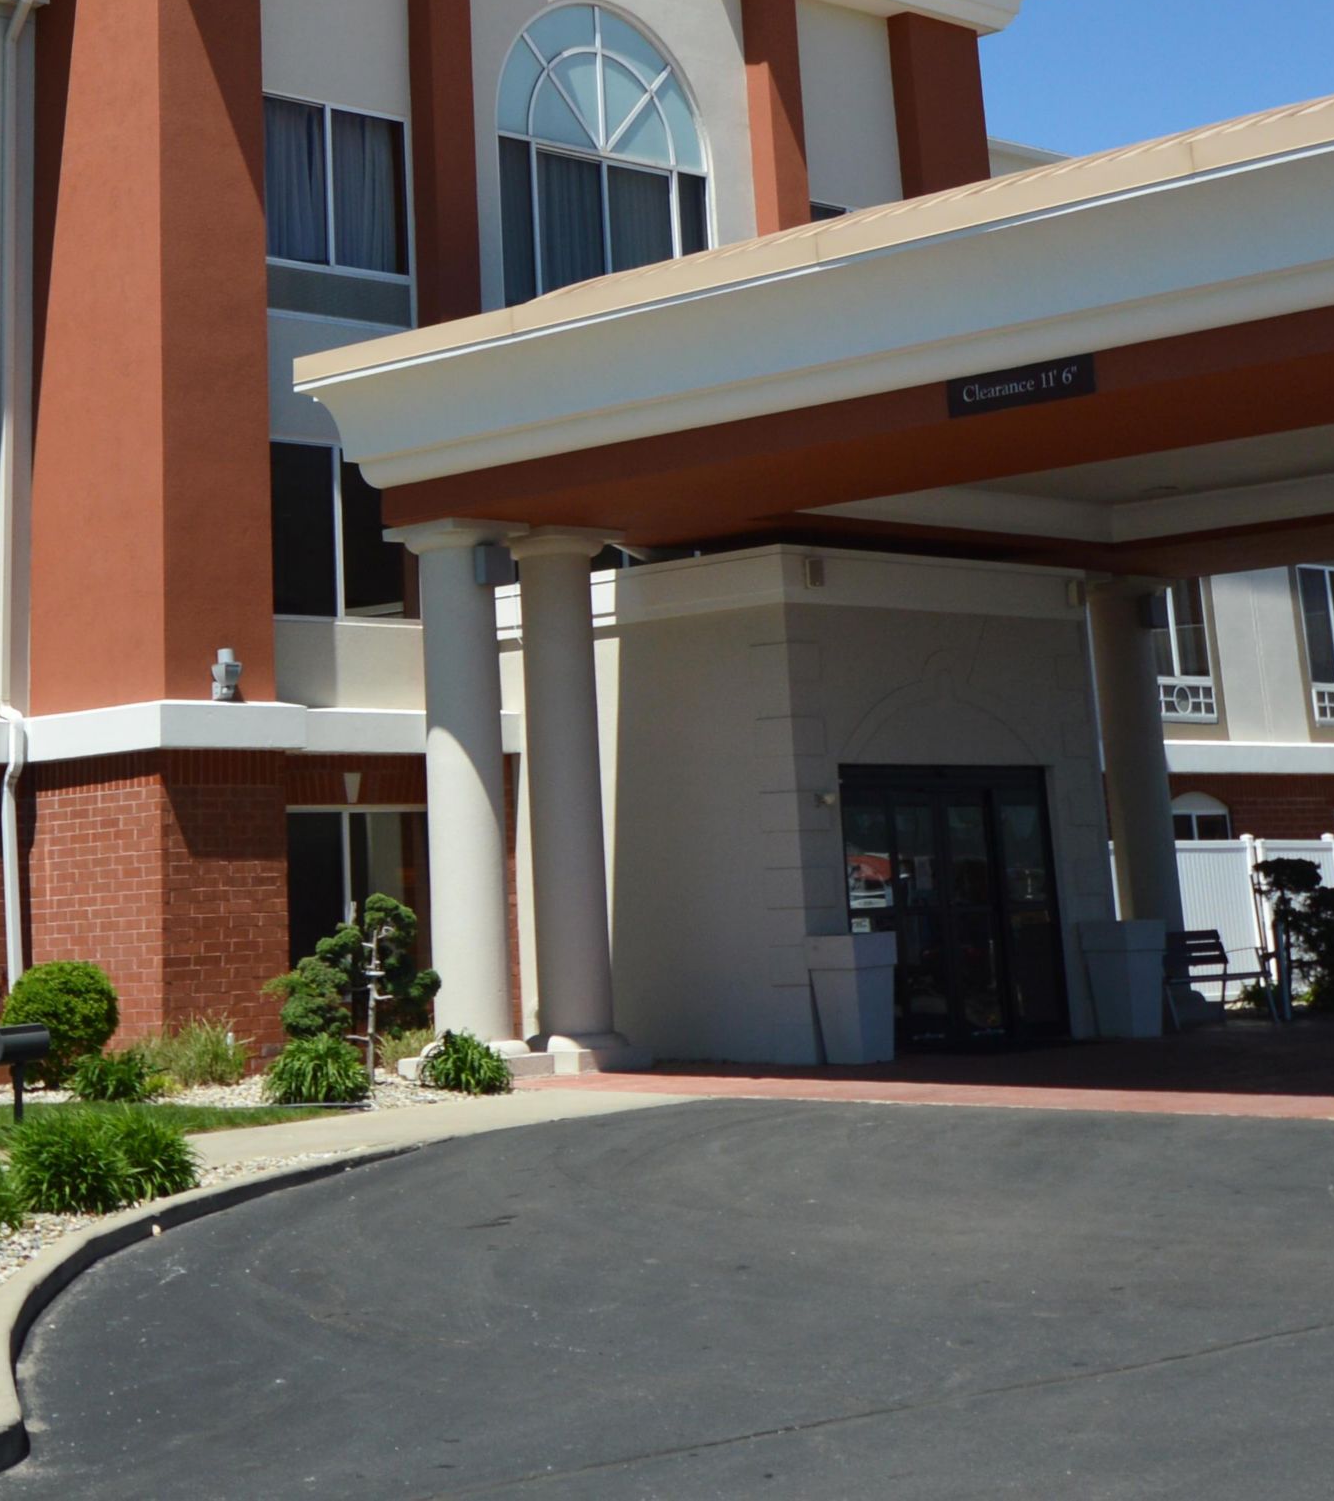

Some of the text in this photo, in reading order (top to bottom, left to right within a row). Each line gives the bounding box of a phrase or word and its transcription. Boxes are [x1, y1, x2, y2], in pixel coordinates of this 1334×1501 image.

[962, 365, 1078, 403] Clearance 11' 6"
